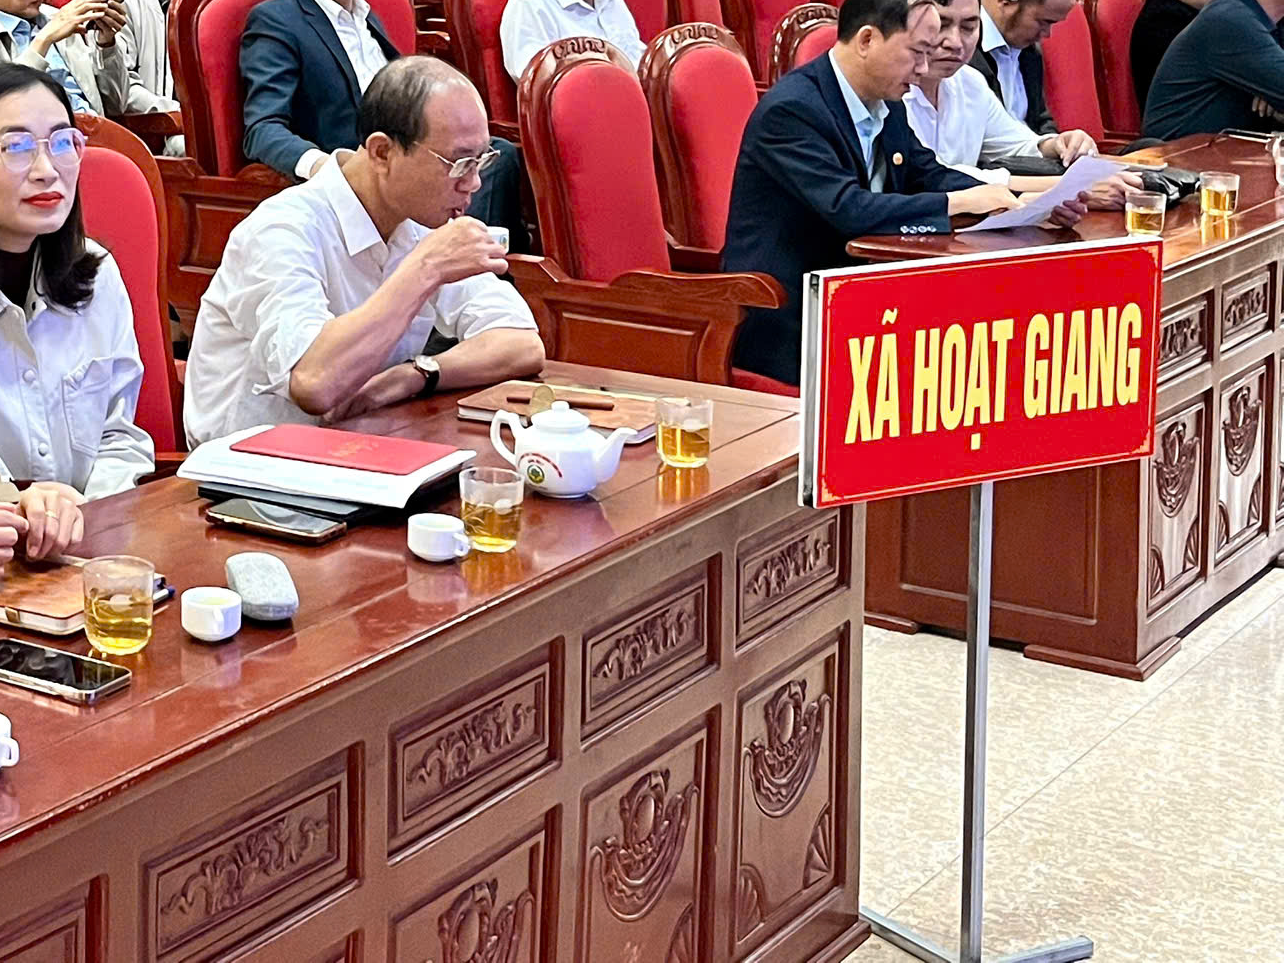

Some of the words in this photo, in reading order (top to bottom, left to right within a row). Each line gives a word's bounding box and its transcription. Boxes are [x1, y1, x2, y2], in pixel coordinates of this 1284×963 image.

[844, 307, 900, 445] XÃ
[911, 318, 1014, 451] HOẠT
[1023, 302, 1143, 419] GIANG
